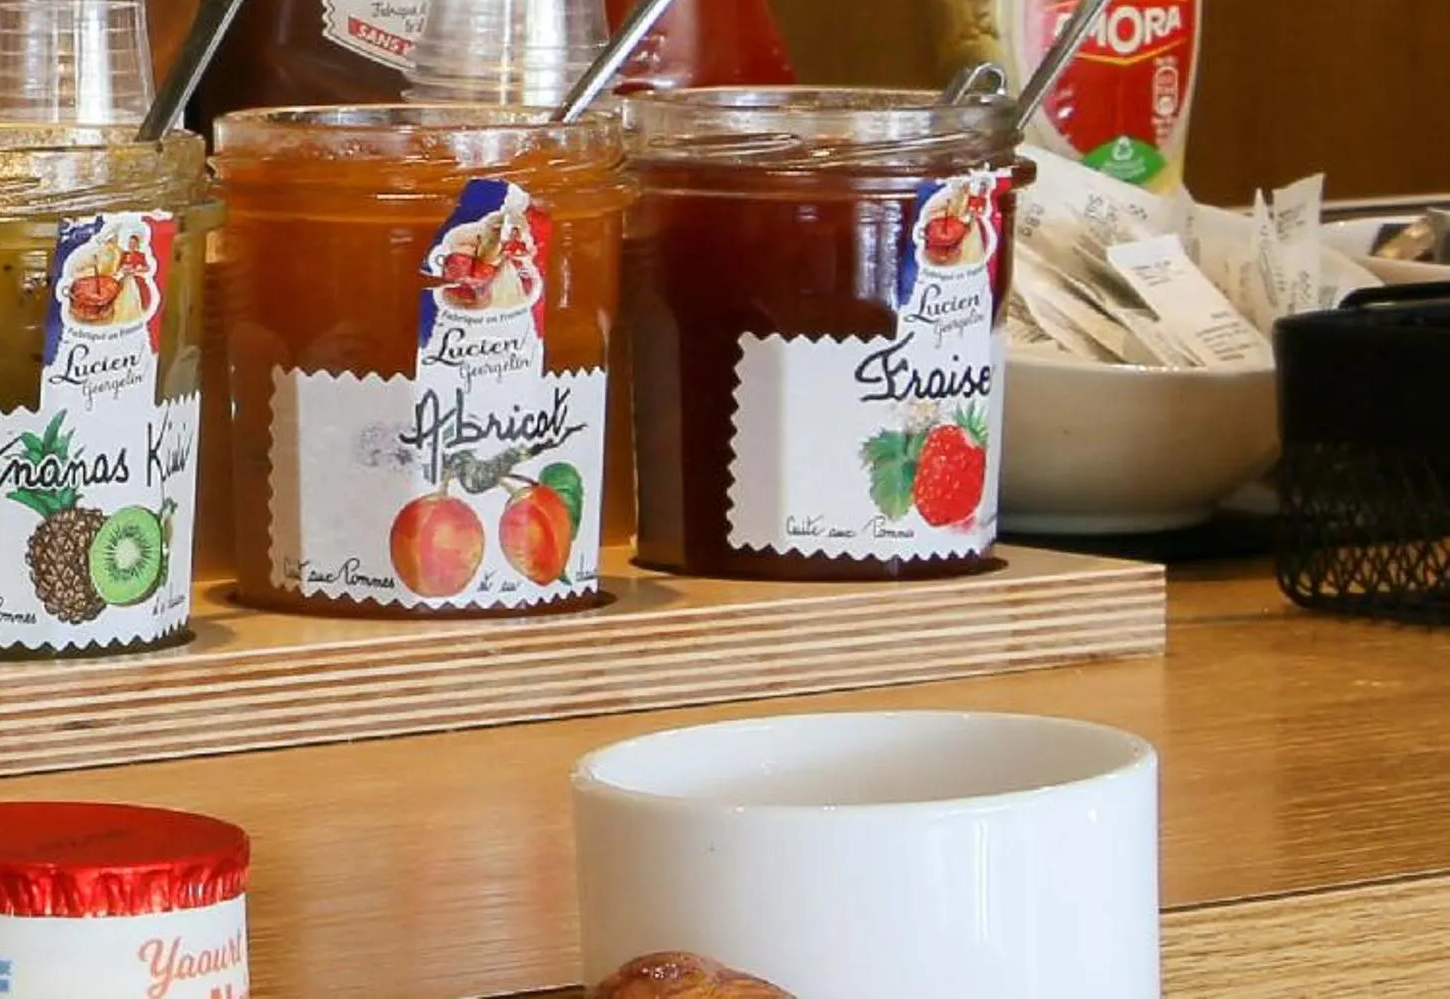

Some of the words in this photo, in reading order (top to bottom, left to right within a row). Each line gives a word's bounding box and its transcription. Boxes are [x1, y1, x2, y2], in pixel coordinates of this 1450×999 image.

[356, 24, 400, 52] SANS
[903, 284, 980, 324] Lucien
[48, 344, 140, 385] Lucien
[421, 327, 522, 367] Lucien
[854, 331, 992, 402] Fraise
[82, 368, 143, 412] Georgelin
[147, 407, 194, 488] Kiwi
[399, 388, 587, 485] Abricot
[138, 927, 241, 999] Yaourt
